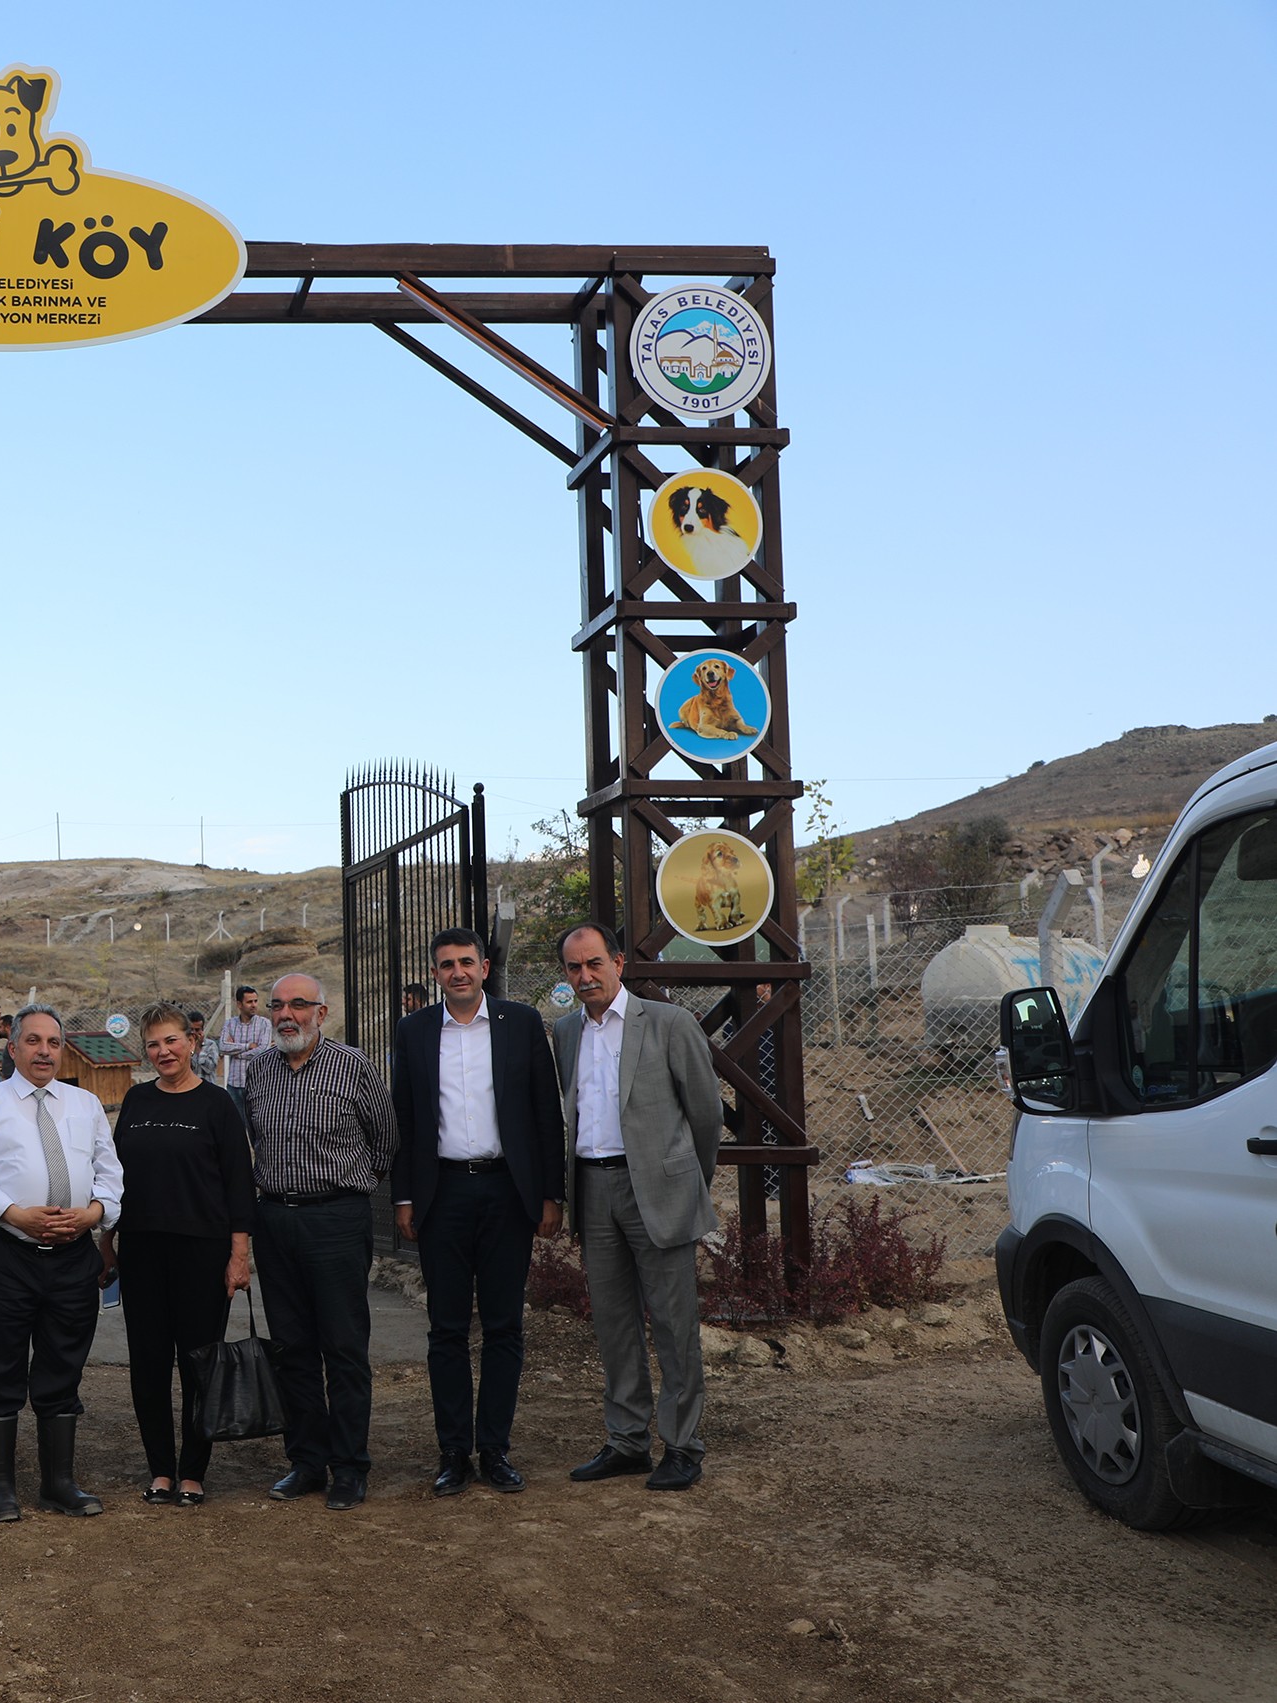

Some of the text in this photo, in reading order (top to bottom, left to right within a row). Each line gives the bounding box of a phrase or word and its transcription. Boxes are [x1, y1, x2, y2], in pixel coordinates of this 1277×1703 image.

[32, 214, 169, 279] KÖY
[11, 295, 83, 308] BARINMA
[86, 295, 107, 308] VE
[36, 312, 101, 325] MERKEZİ
[641, 294, 762, 366] TALAS BELEDİYESİ
[682, 395, 720, 409] 1907
